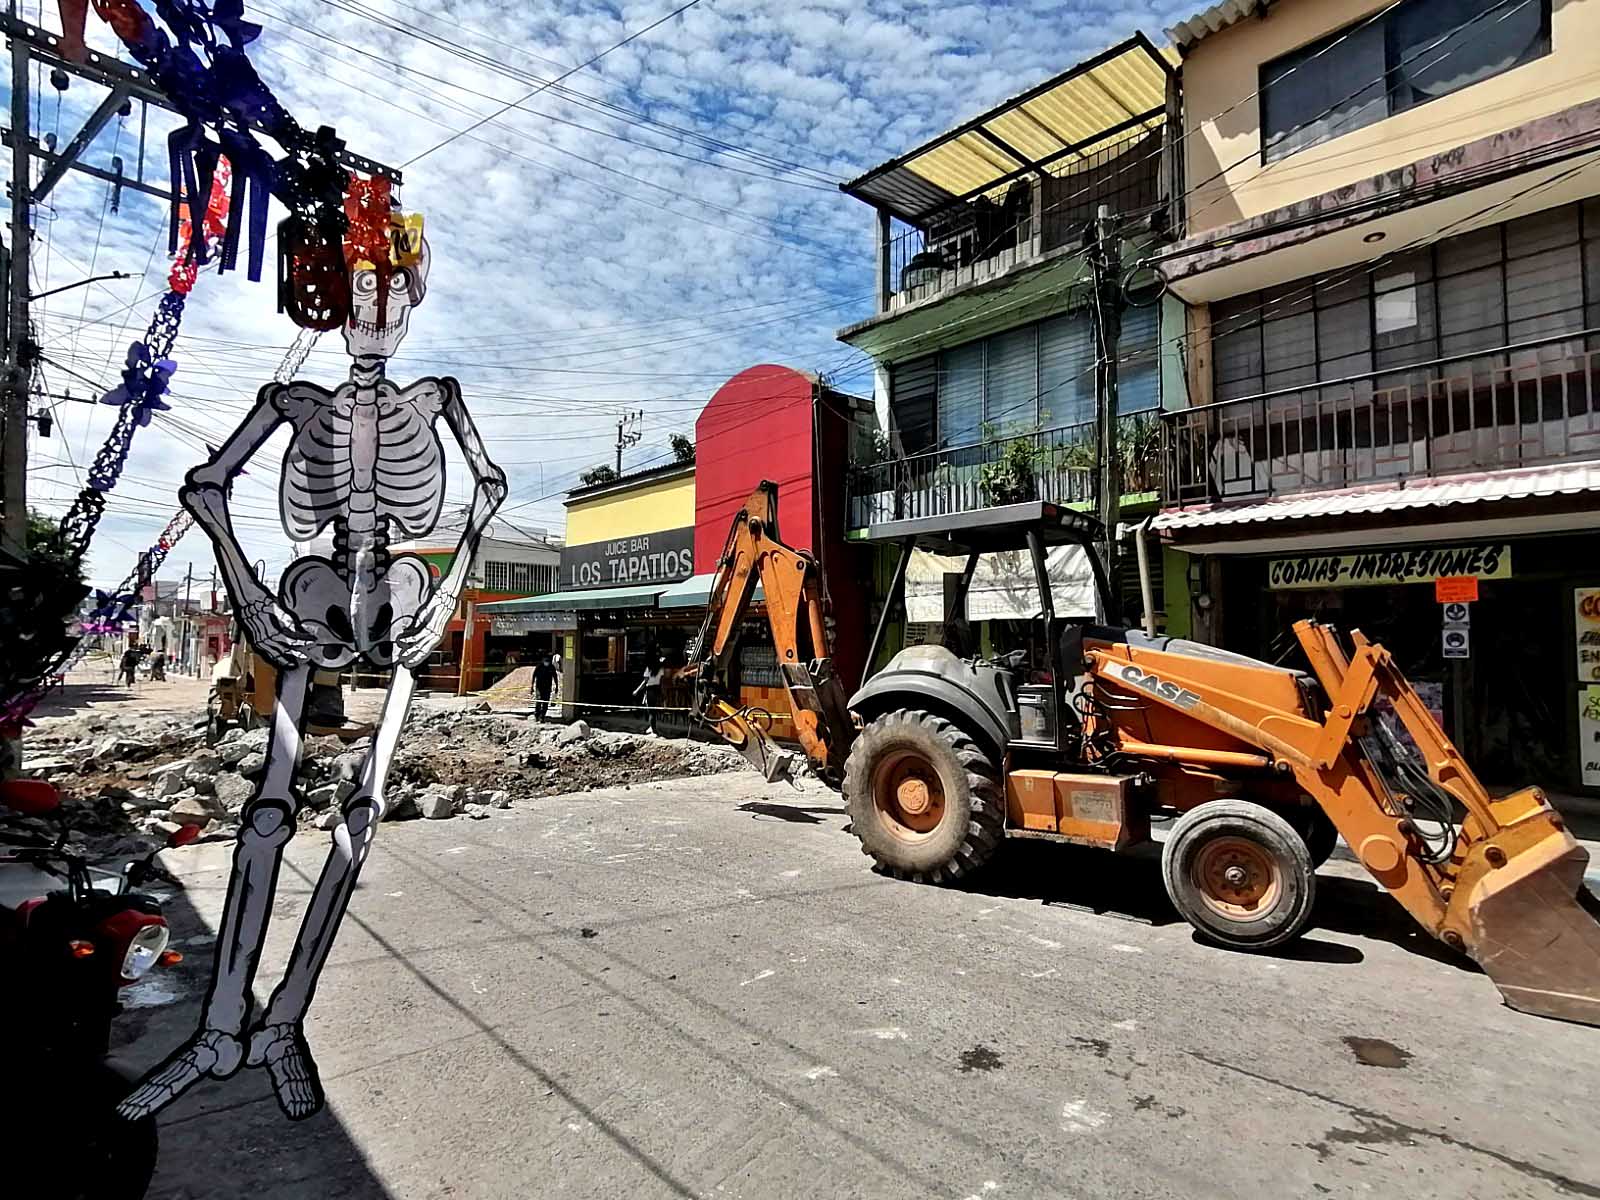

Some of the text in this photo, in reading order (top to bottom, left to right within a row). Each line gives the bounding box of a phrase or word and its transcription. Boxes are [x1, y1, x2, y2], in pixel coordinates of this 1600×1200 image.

[605, 536, 649, 555] JUICE BAR
[571, 548, 692, 587] LOS TAPATIOS
[1121, 666, 1201, 709] CASE
